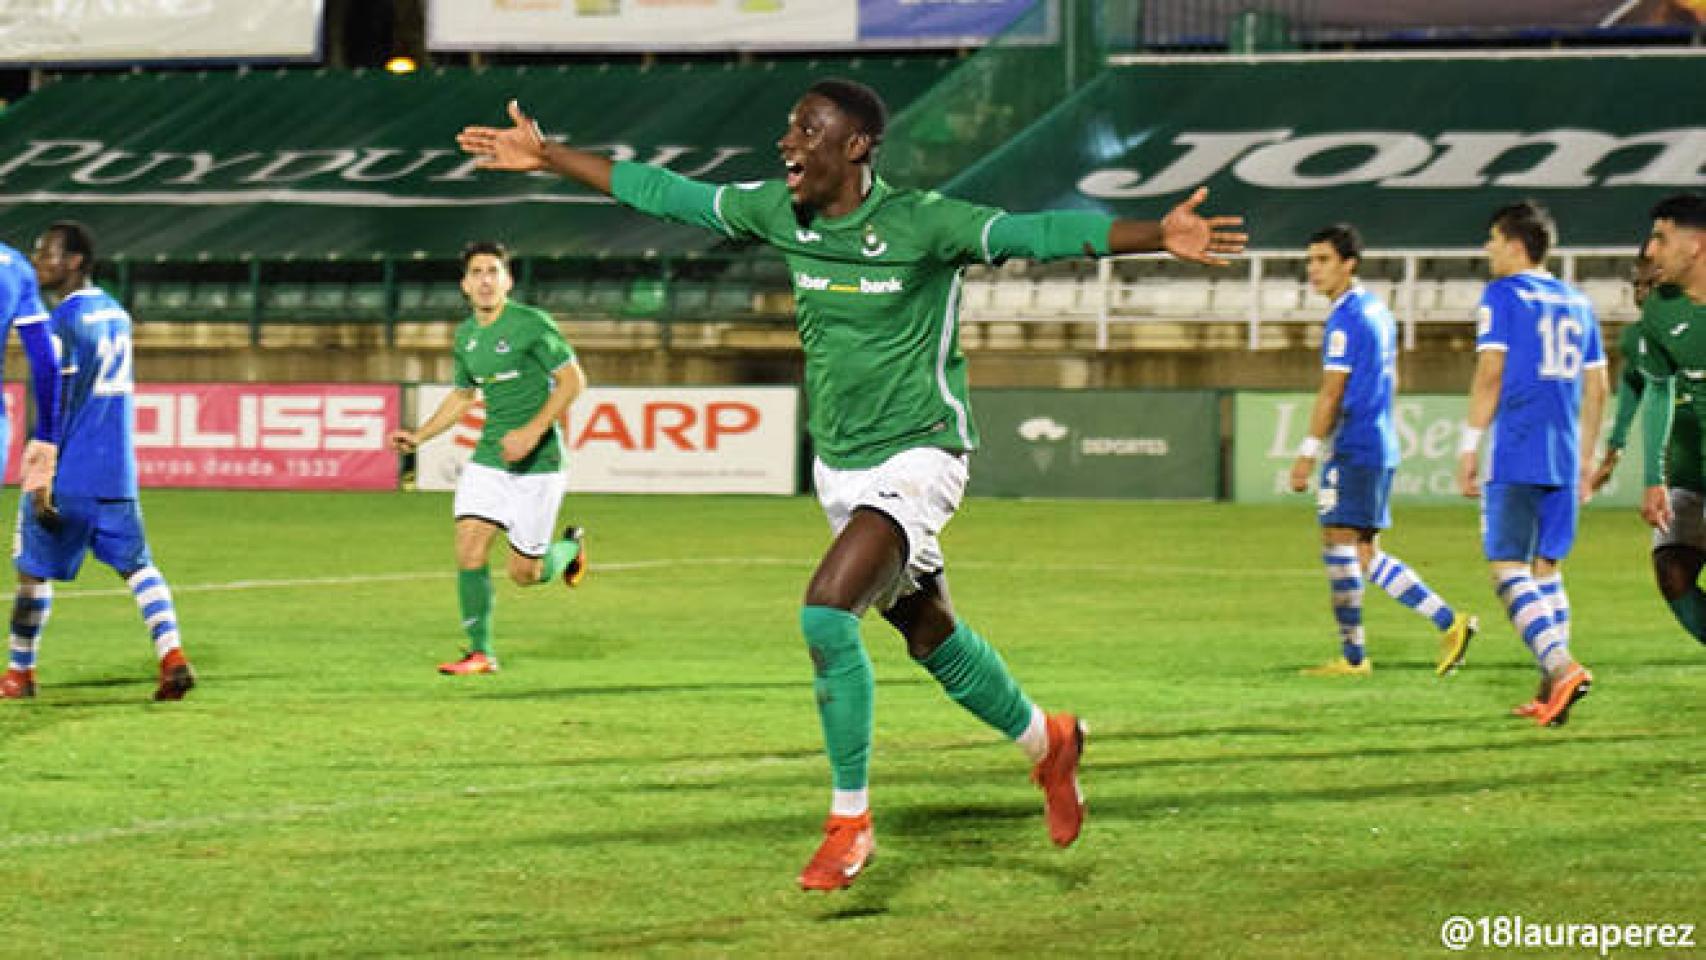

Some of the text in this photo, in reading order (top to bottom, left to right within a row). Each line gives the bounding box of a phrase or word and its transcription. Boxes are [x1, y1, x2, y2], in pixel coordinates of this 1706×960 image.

[860, 276, 902, 293] bank
[94, 333, 133, 394] 22
[1538, 315, 1583, 379] 16
